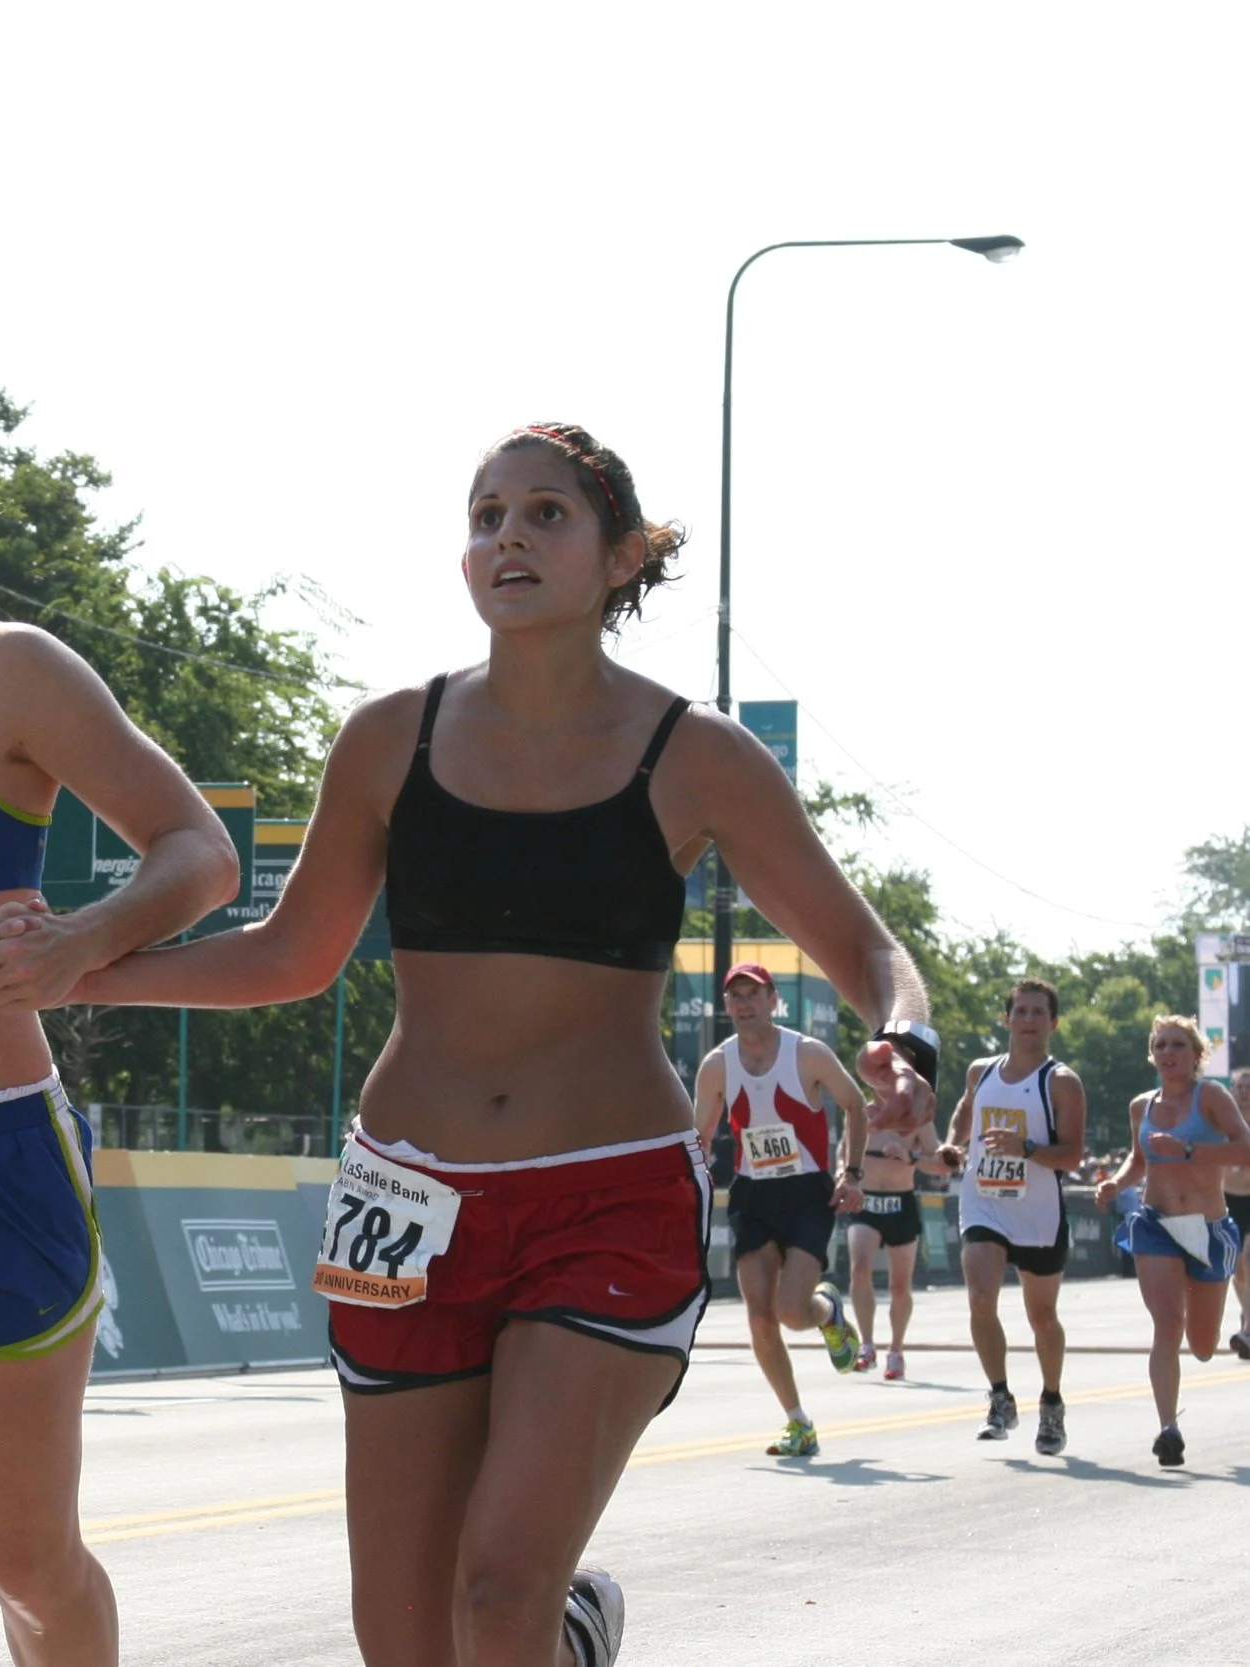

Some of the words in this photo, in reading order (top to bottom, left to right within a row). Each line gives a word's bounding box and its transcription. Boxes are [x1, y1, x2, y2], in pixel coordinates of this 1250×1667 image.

[93, 856, 139, 877] nergiz
[750, 1141, 761, 1159] A
[764, 1136, 791, 1158] 460
[343, 1156, 388, 1190] LaSalle
[390, 1179, 430, 1207] Bank
[977, 1158, 985, 1177] A
[989, 1160, 1025, 1181] 1754
[328, 1193, 424, 1280] 784
[325, 1273, 411, 1299] ANNIVERSARY
